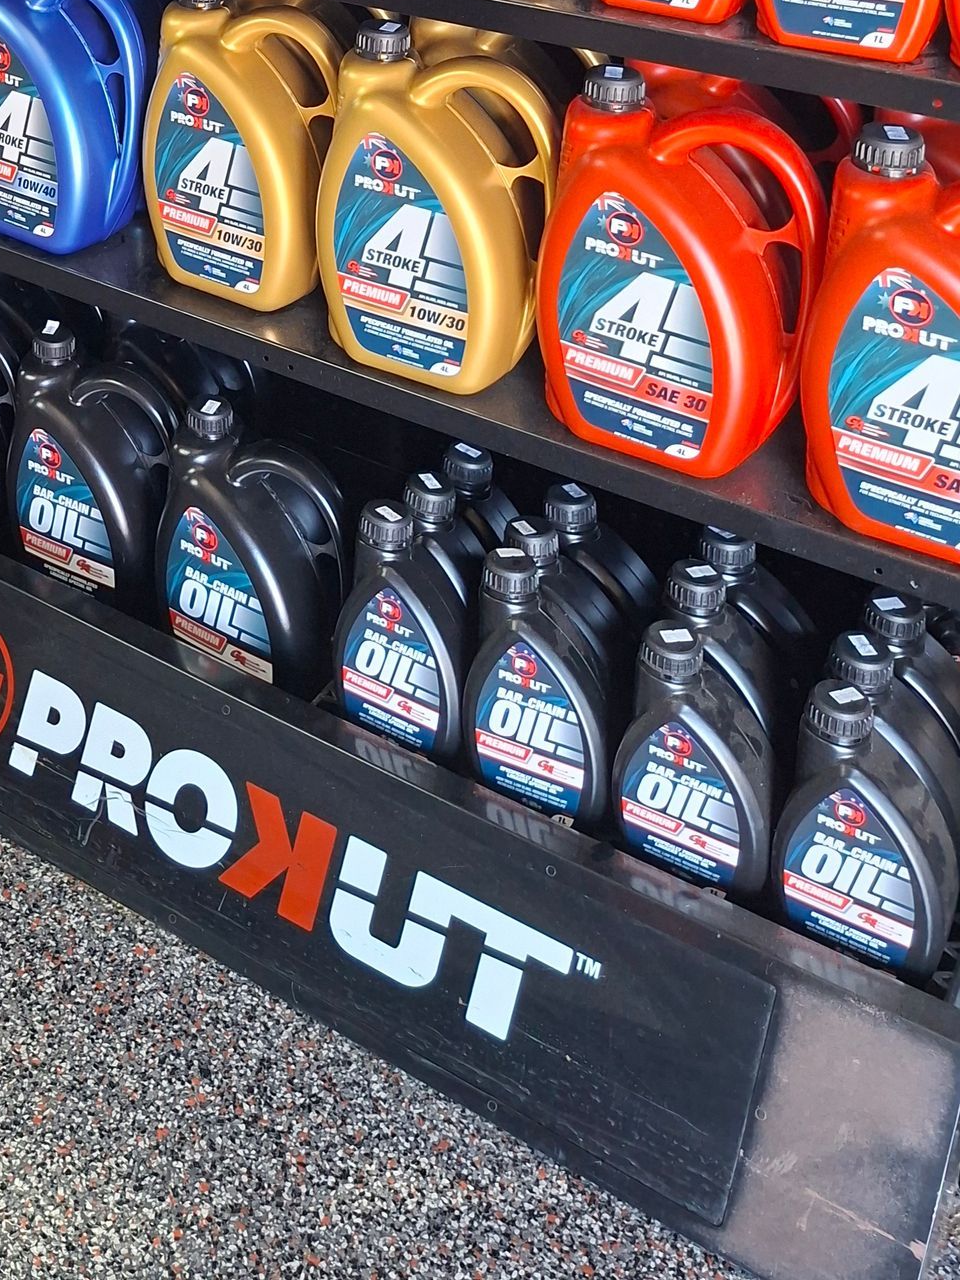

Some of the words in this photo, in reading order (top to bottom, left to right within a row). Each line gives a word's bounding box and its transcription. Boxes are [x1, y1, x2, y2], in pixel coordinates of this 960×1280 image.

[170, 111, 225, 134] PROKUT
[17, 176, 57, 200] 10W/40
[177, 137, 234, 215] 4
[181, 177, 228, 202] STROKE
[354, 174, 421, 201] PROKUT
[163, 205, 210, 230] PREMIUM
[216, 227, 263, 253] 10W/30
[361, 203, 432, 289] 4
[584, 236, 663, 270] PROKUT
[366, 247, 422, 274] STROKE
[342, 278, 402, 306] PREMIUM
[408, 303, 466, 333] 10W/30
[590, 271, 675, 364] 4
[595, 317, 660, 348] STROKE
[862, 315, 959, 351] PROKUT
[565, 349, 634, 381] PREMIUM
[645, 381, 681, 405] SAE
[683, 396, 707, 413] 30
[867, 354, 960, 454] 4
[873, 404, 951, 436] STROKE
[838, 435, 921, 473] PREMIUM
[28, 460, 75, 485] PROKUT
[934, 473, 960, 493] SA
[28, 496, 84, 548] OIL
[25, 532, 68, 560] PREMIUM
[179, 539, 232, 572] PROKUT
[179, 580, 239, 639] OIL
[366, 612, 414, 637] PROKUT
[175, 614, 221, 648] PREMIUM
[355, 640, 416, 694] OIL
[498, 669, 552, 693] PROKUT
[345, 672, 389, 698] PREMIUM
[488, 698, 554, 752] OIL
[479, 734, 527, 760] PREMIUM
[648, 744, 709, 773] PROKUT
[625, 803, 676, 830] PREMIUM
[636, 773, 709, 830] OIL
[817, 813, 882, 845] PROKUT
[9, 669, 575, 1042] PROKUT
[788, 875, 845, 908] PREMIUM
[801, 845, 882, 907] OIL
